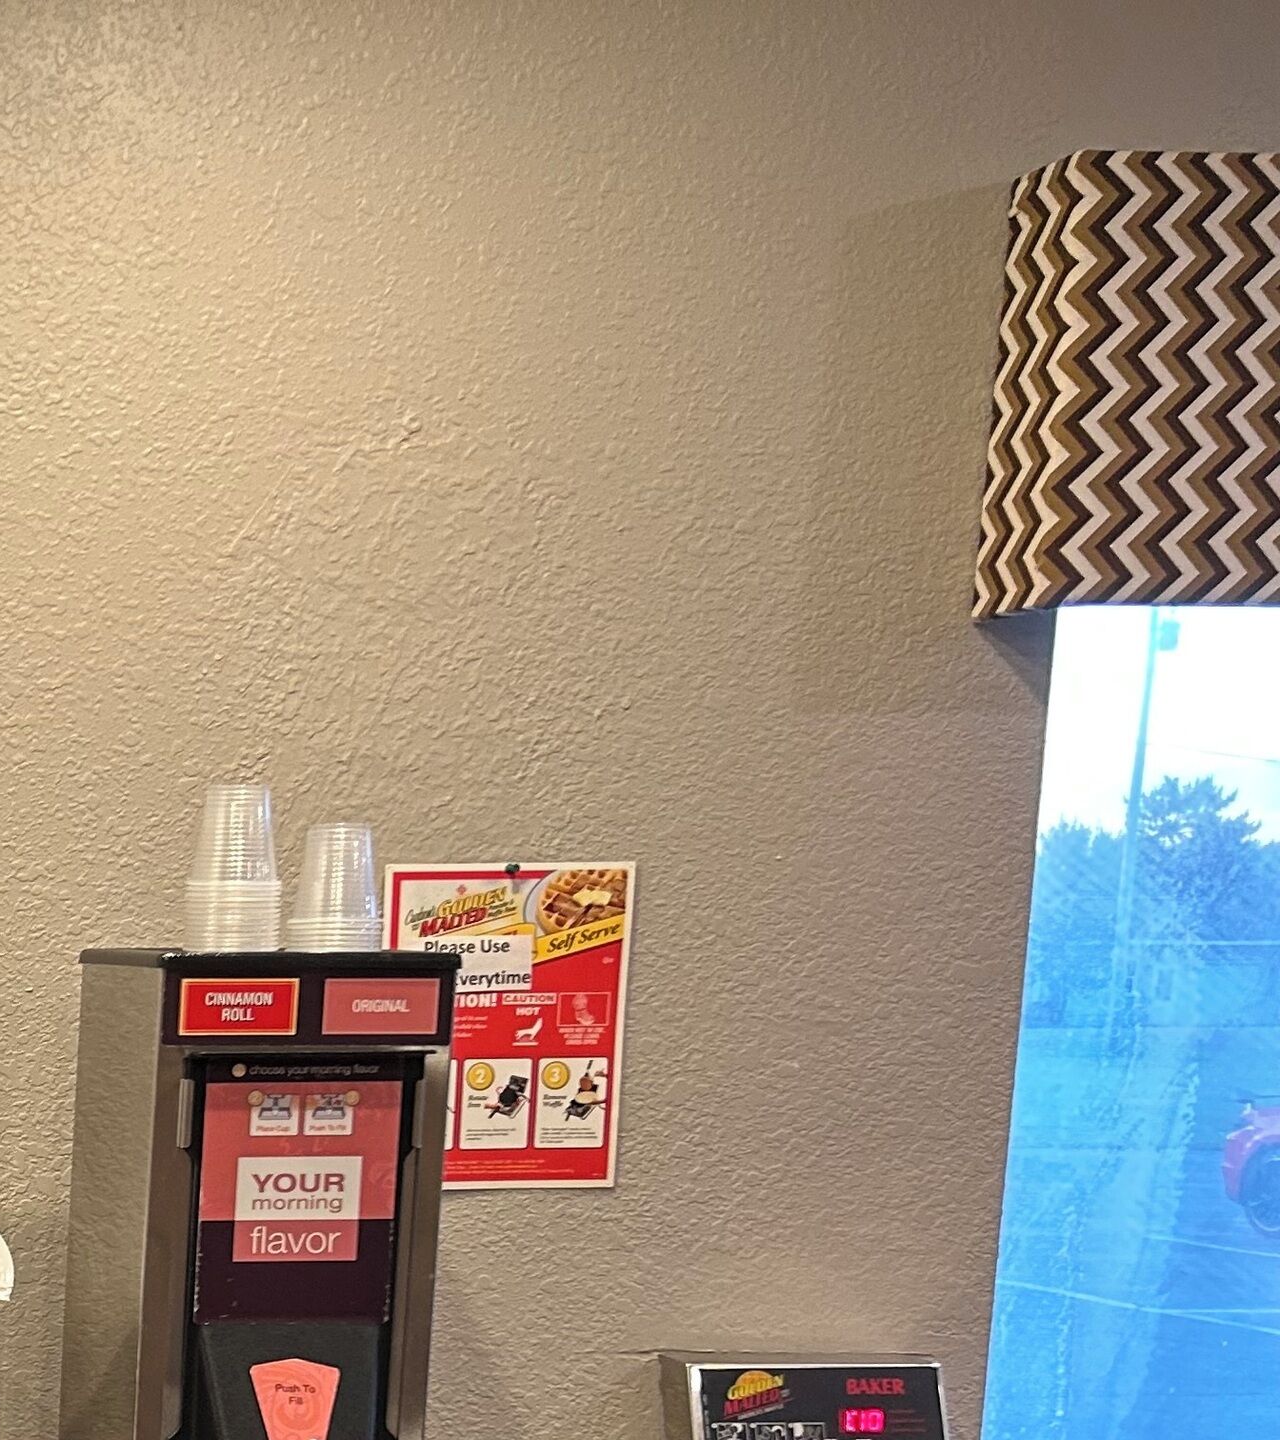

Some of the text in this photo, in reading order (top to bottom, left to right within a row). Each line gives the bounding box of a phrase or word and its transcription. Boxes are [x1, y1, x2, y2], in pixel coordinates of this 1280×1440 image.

[419, 907, 488, 937] MALTED
[547, 924, 621, 953] Self Serve
[424, 940, 511, 955] Please Use
[455, 970, 532, 989] verytime
[205, 992, 273, 1006] CINNAMON
[352, 999, 410, 1013] ORIGINAL
[503, 994, 555, 1003] CAUTION
[221, 1008, 255, 1022] ROLL
[516, 1007, 540, 1016] HOT
[249, 1065, 286, 1075] choose
[287, 1065, 308, 1077] your
[309, 1065, 351, 1076] morning
[475, 1069, 486, 1084] 2
[551, 1068, 562, 1083] 3
[251, 1173, 345, 1193] YOUR
[251, 1195, 344, 1214] morning
[250, 1225, 342, 1254] flavor
[275, 1383, 316, 1393] Push To
[727, 1374, 785, 1400] GOLDEN
[846, 1378, 905, 1395] BAKER
[723, 1387, 781, 1417] MALTED
